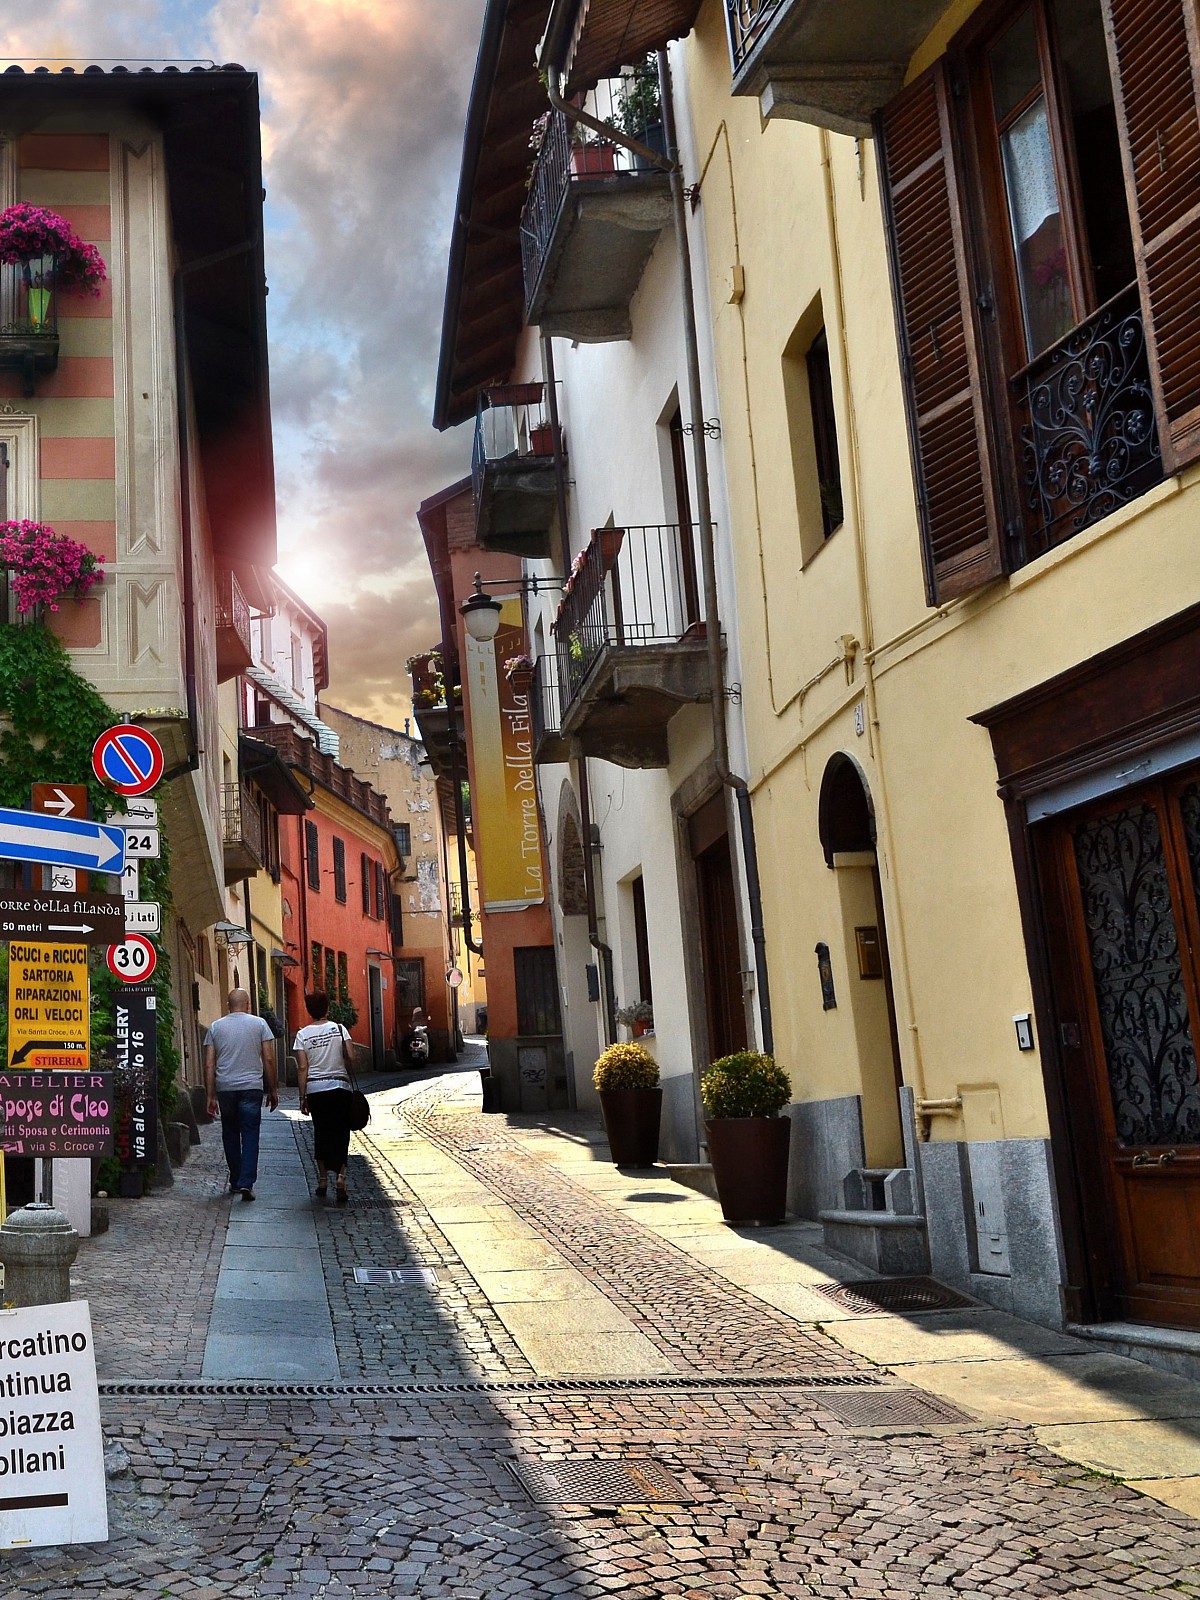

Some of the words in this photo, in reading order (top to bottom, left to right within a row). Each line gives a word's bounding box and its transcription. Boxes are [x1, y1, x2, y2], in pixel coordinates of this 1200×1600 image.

[502, 694, 530, 735] Fila
[506, 740, 535, 791] della
[522, 797, 541, 859] Torre
[128, 836, 152, 850] 24
[524, 864, 543, 896] La
[137, 912, 155, 922] lati
[2, 922, 15, 931] 50
[18, 923, 42, 932] metri
[10, 945, 40, 962] SCUCI
[44, 952, 50, 963] e
[52, 948, 87, 964] RICUCI
[117, 948, 145, 968] 30
[22, 968, 74, 983] SARTORIA
[15, 988, 82, 1002] RIPARAZIONI
[14, 1007, 39, 1021] ORLI
[45, 1008, 83, 1021] VELOCI
[28, 1028, 47, 1036] Santa
[116, 1005, 129, 1070] ALLERY
[131, 1031, 145, 1048] 16
[34, 1056, 83, 1066] STIRERIA
[50, 1094, 64, 1117] di
[70, 1093, 109, 1122] Cleo
[4, 1125, 15, 1136] iti
[18, 1125, 48, 1138] Sposa
[52, 1127, 57, 1136] e
[60, 1124, 110, 1136] Cerimonia
[132, 1117, 145, 1132] al
[30, 1142, 47, 1151] via
[49, 1142, 60, 1151] S.
[64, 1142, 95, 1151] Croce
[99, 1142, 105, 1151] 7
[133, 1136, 145, 1158] via
